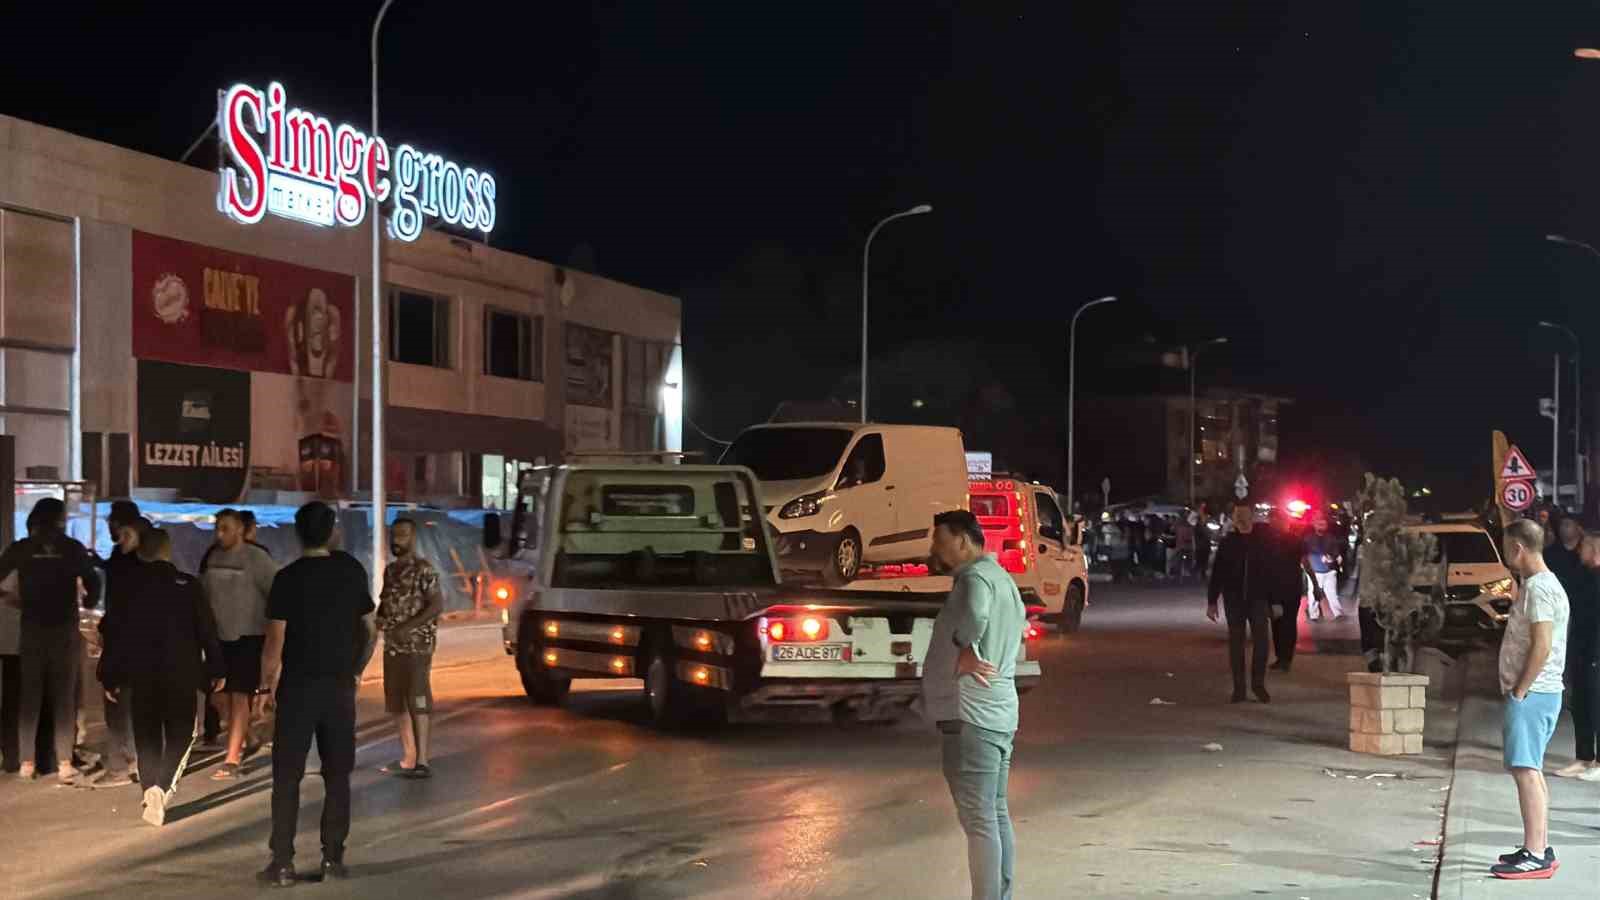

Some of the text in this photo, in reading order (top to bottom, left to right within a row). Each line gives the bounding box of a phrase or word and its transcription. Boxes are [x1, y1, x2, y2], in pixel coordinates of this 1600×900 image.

[224, 81, 497, 242] Simge gross
[271, 186, 332, 219] market
[145, 440, 245, 468] LEZZET AİLESİ
[1507, 488, 1527, 502] 30
[780, 647, 841, 659] 26 ADE 817
